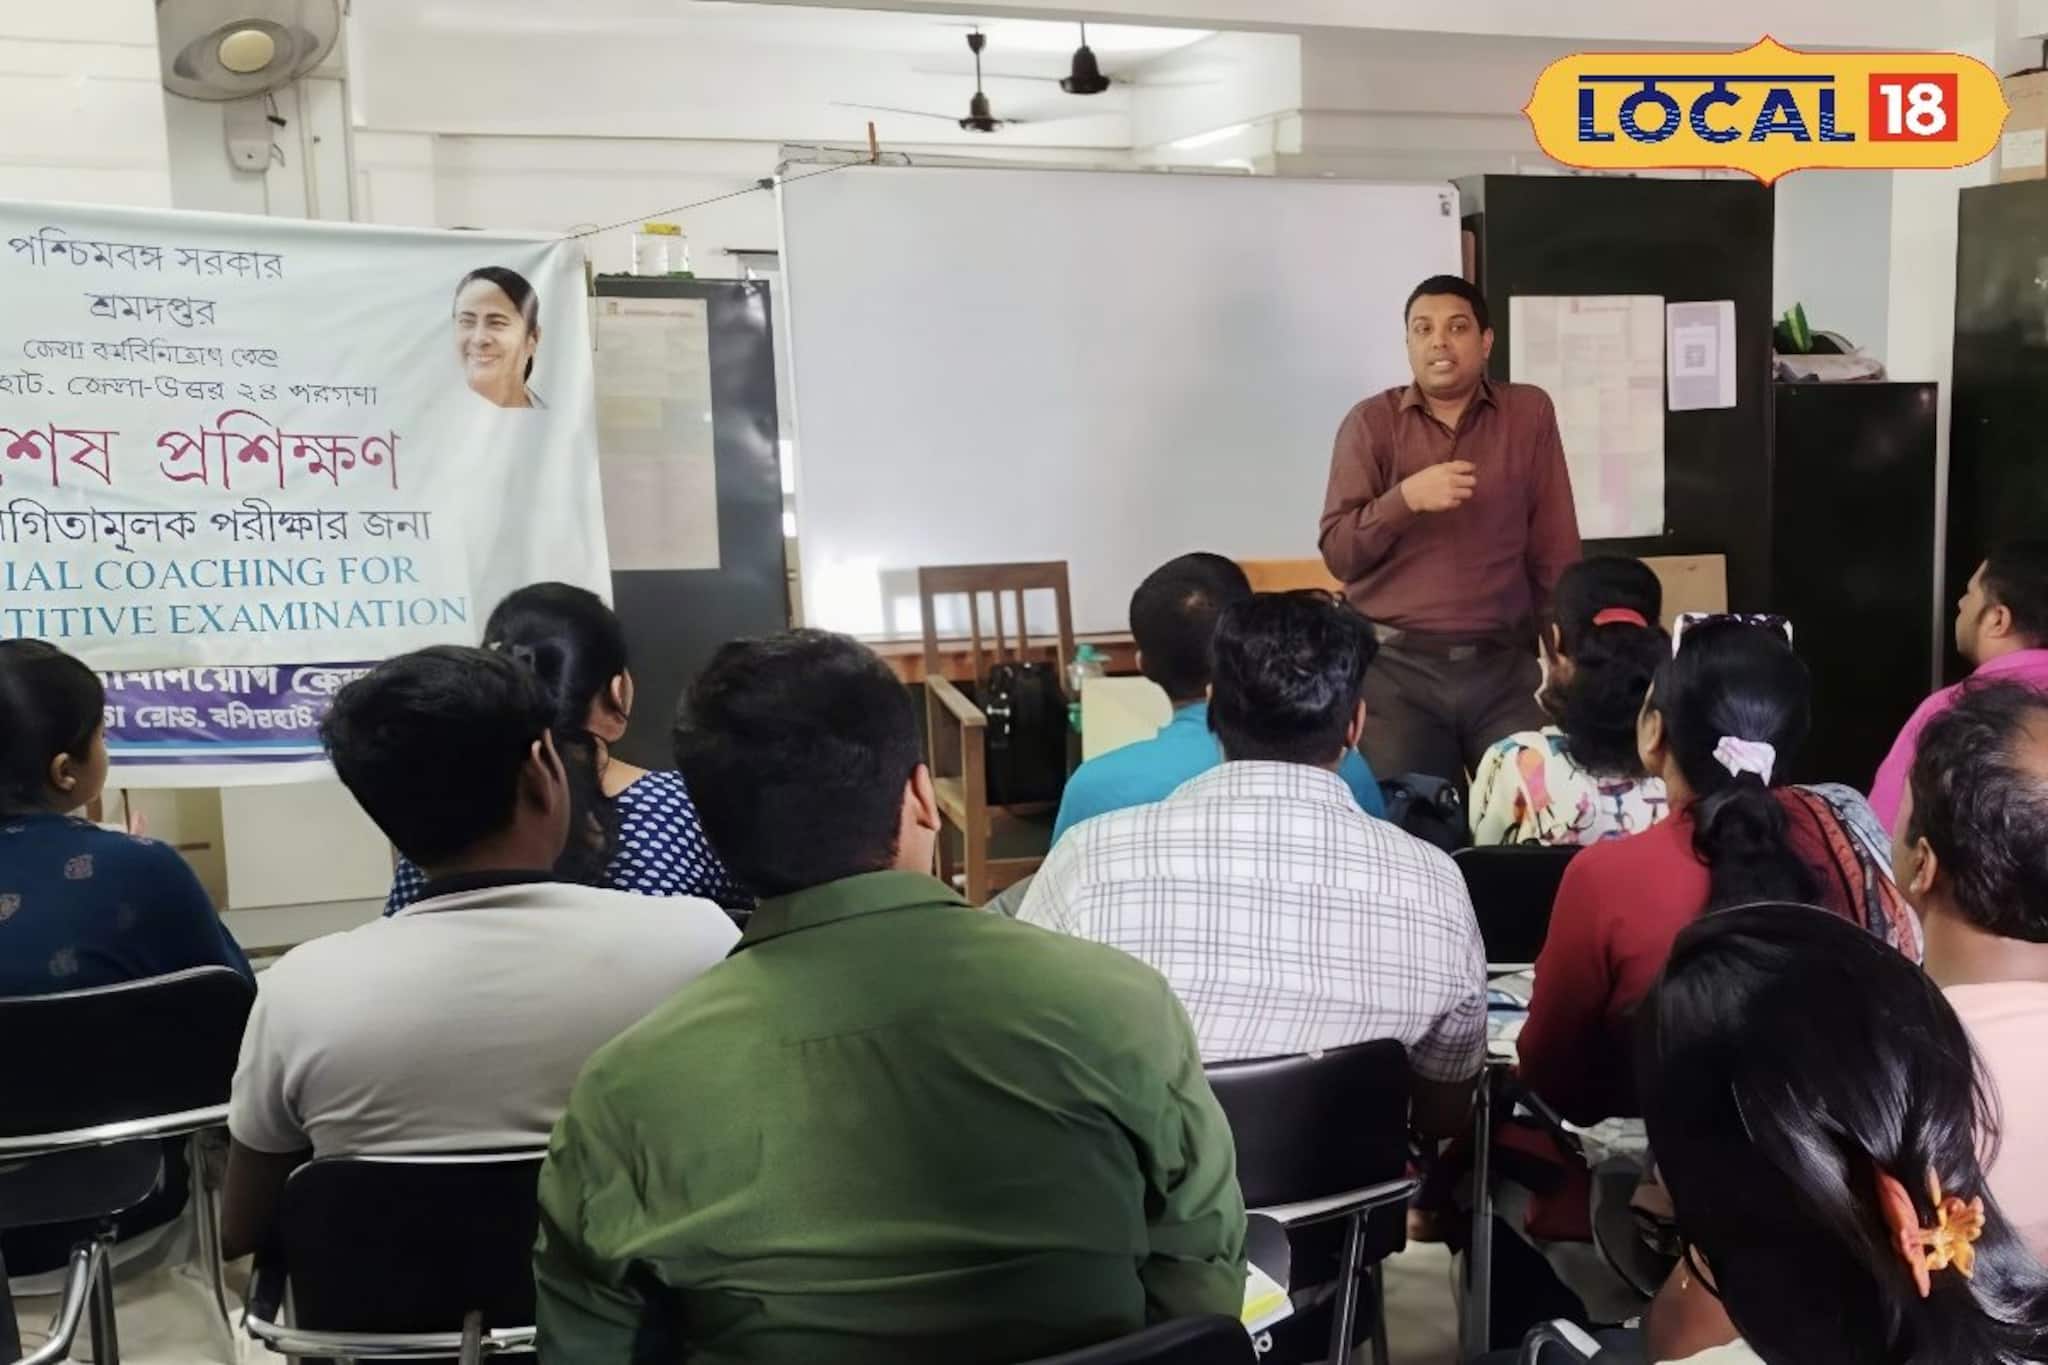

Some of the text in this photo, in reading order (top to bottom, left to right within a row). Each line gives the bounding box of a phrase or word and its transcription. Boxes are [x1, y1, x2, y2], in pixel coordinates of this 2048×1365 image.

[8, 226, 284, 280] পশ্চিমবঙ্গ সরকার
[156, 408, 401, 490] প্রশিক্ষণ
[209, 497, 348, 542] পরীক্ষার
[5, 555, 420, 592] IAL COACHING FOR
[168, 595, 468, 637] EXAMINATION
